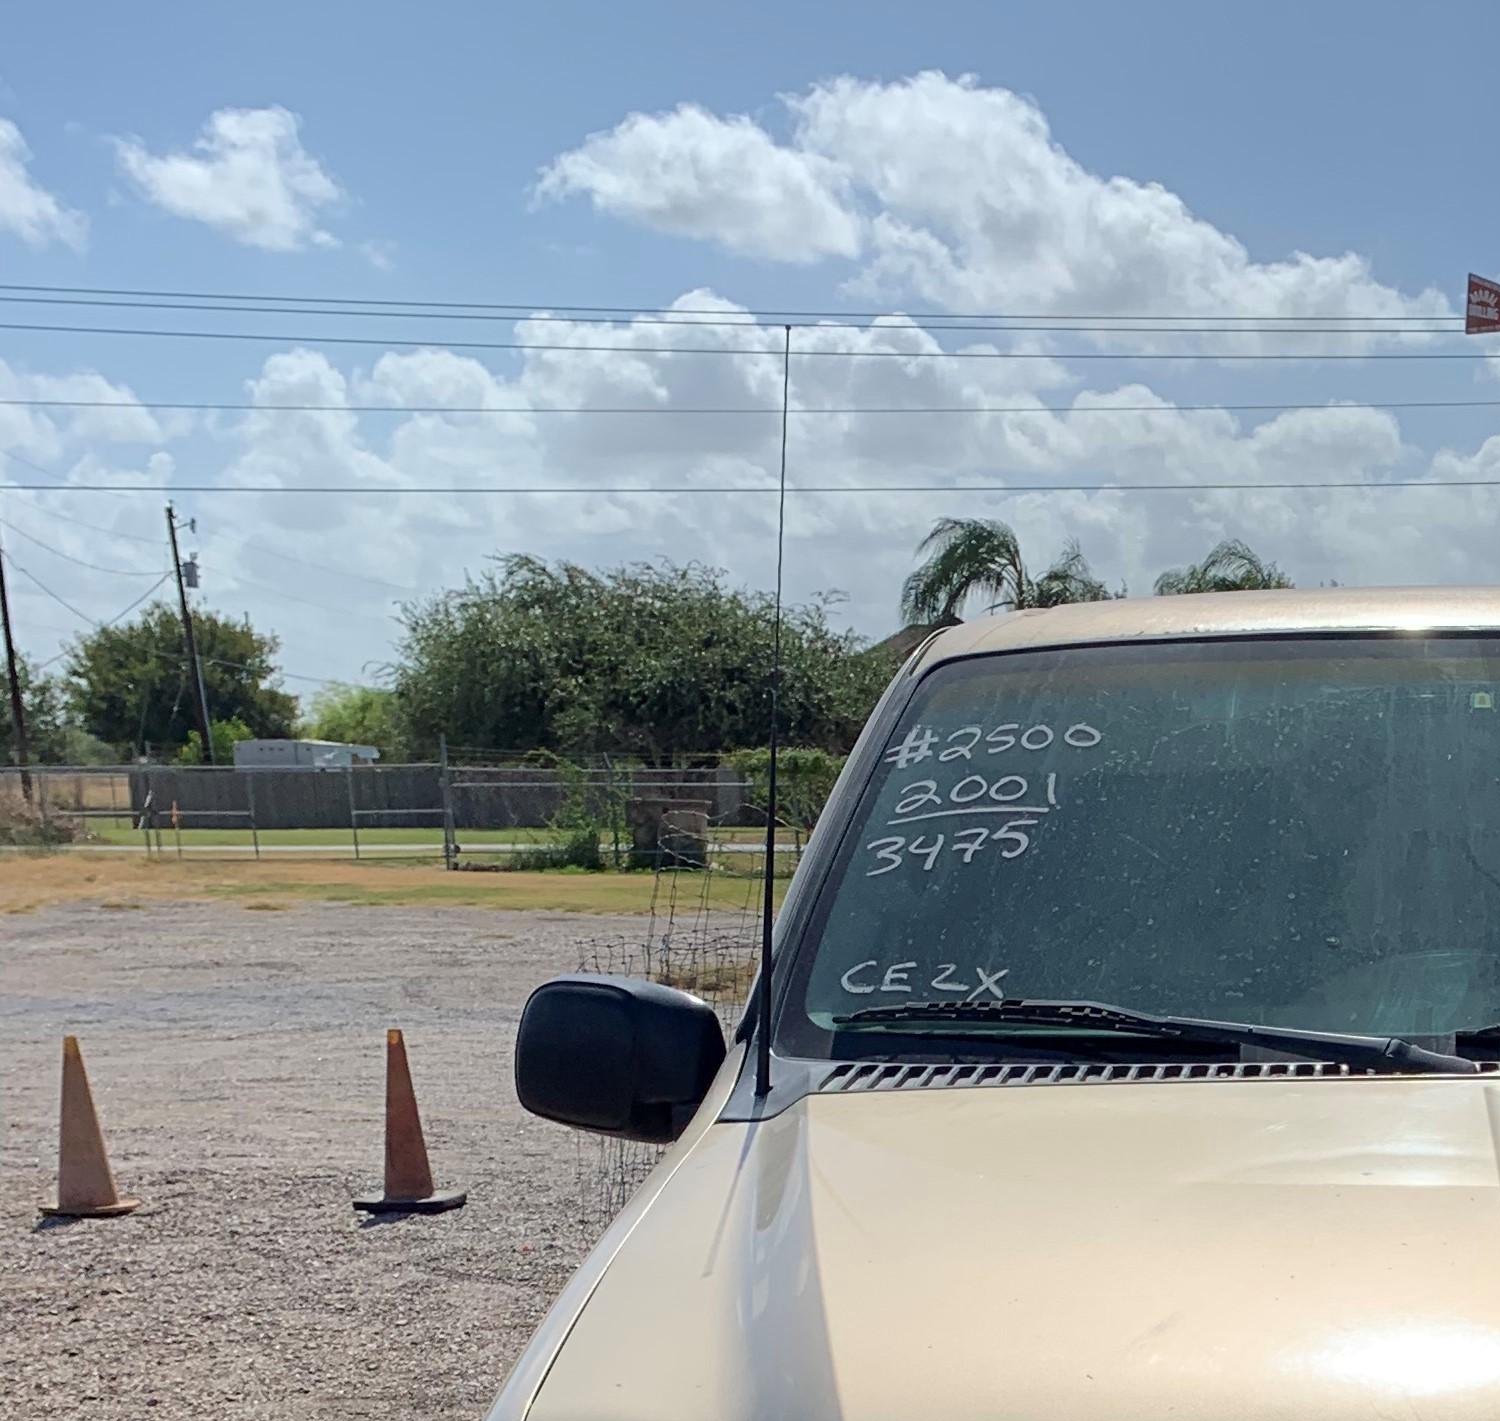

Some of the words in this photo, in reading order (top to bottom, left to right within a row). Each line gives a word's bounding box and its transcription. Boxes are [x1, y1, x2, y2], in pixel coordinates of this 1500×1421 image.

[884, 722, 1102, 769] #2500
[895, 773, 1057, 814] 2001
[866, 819, 1039, 877] 3475
